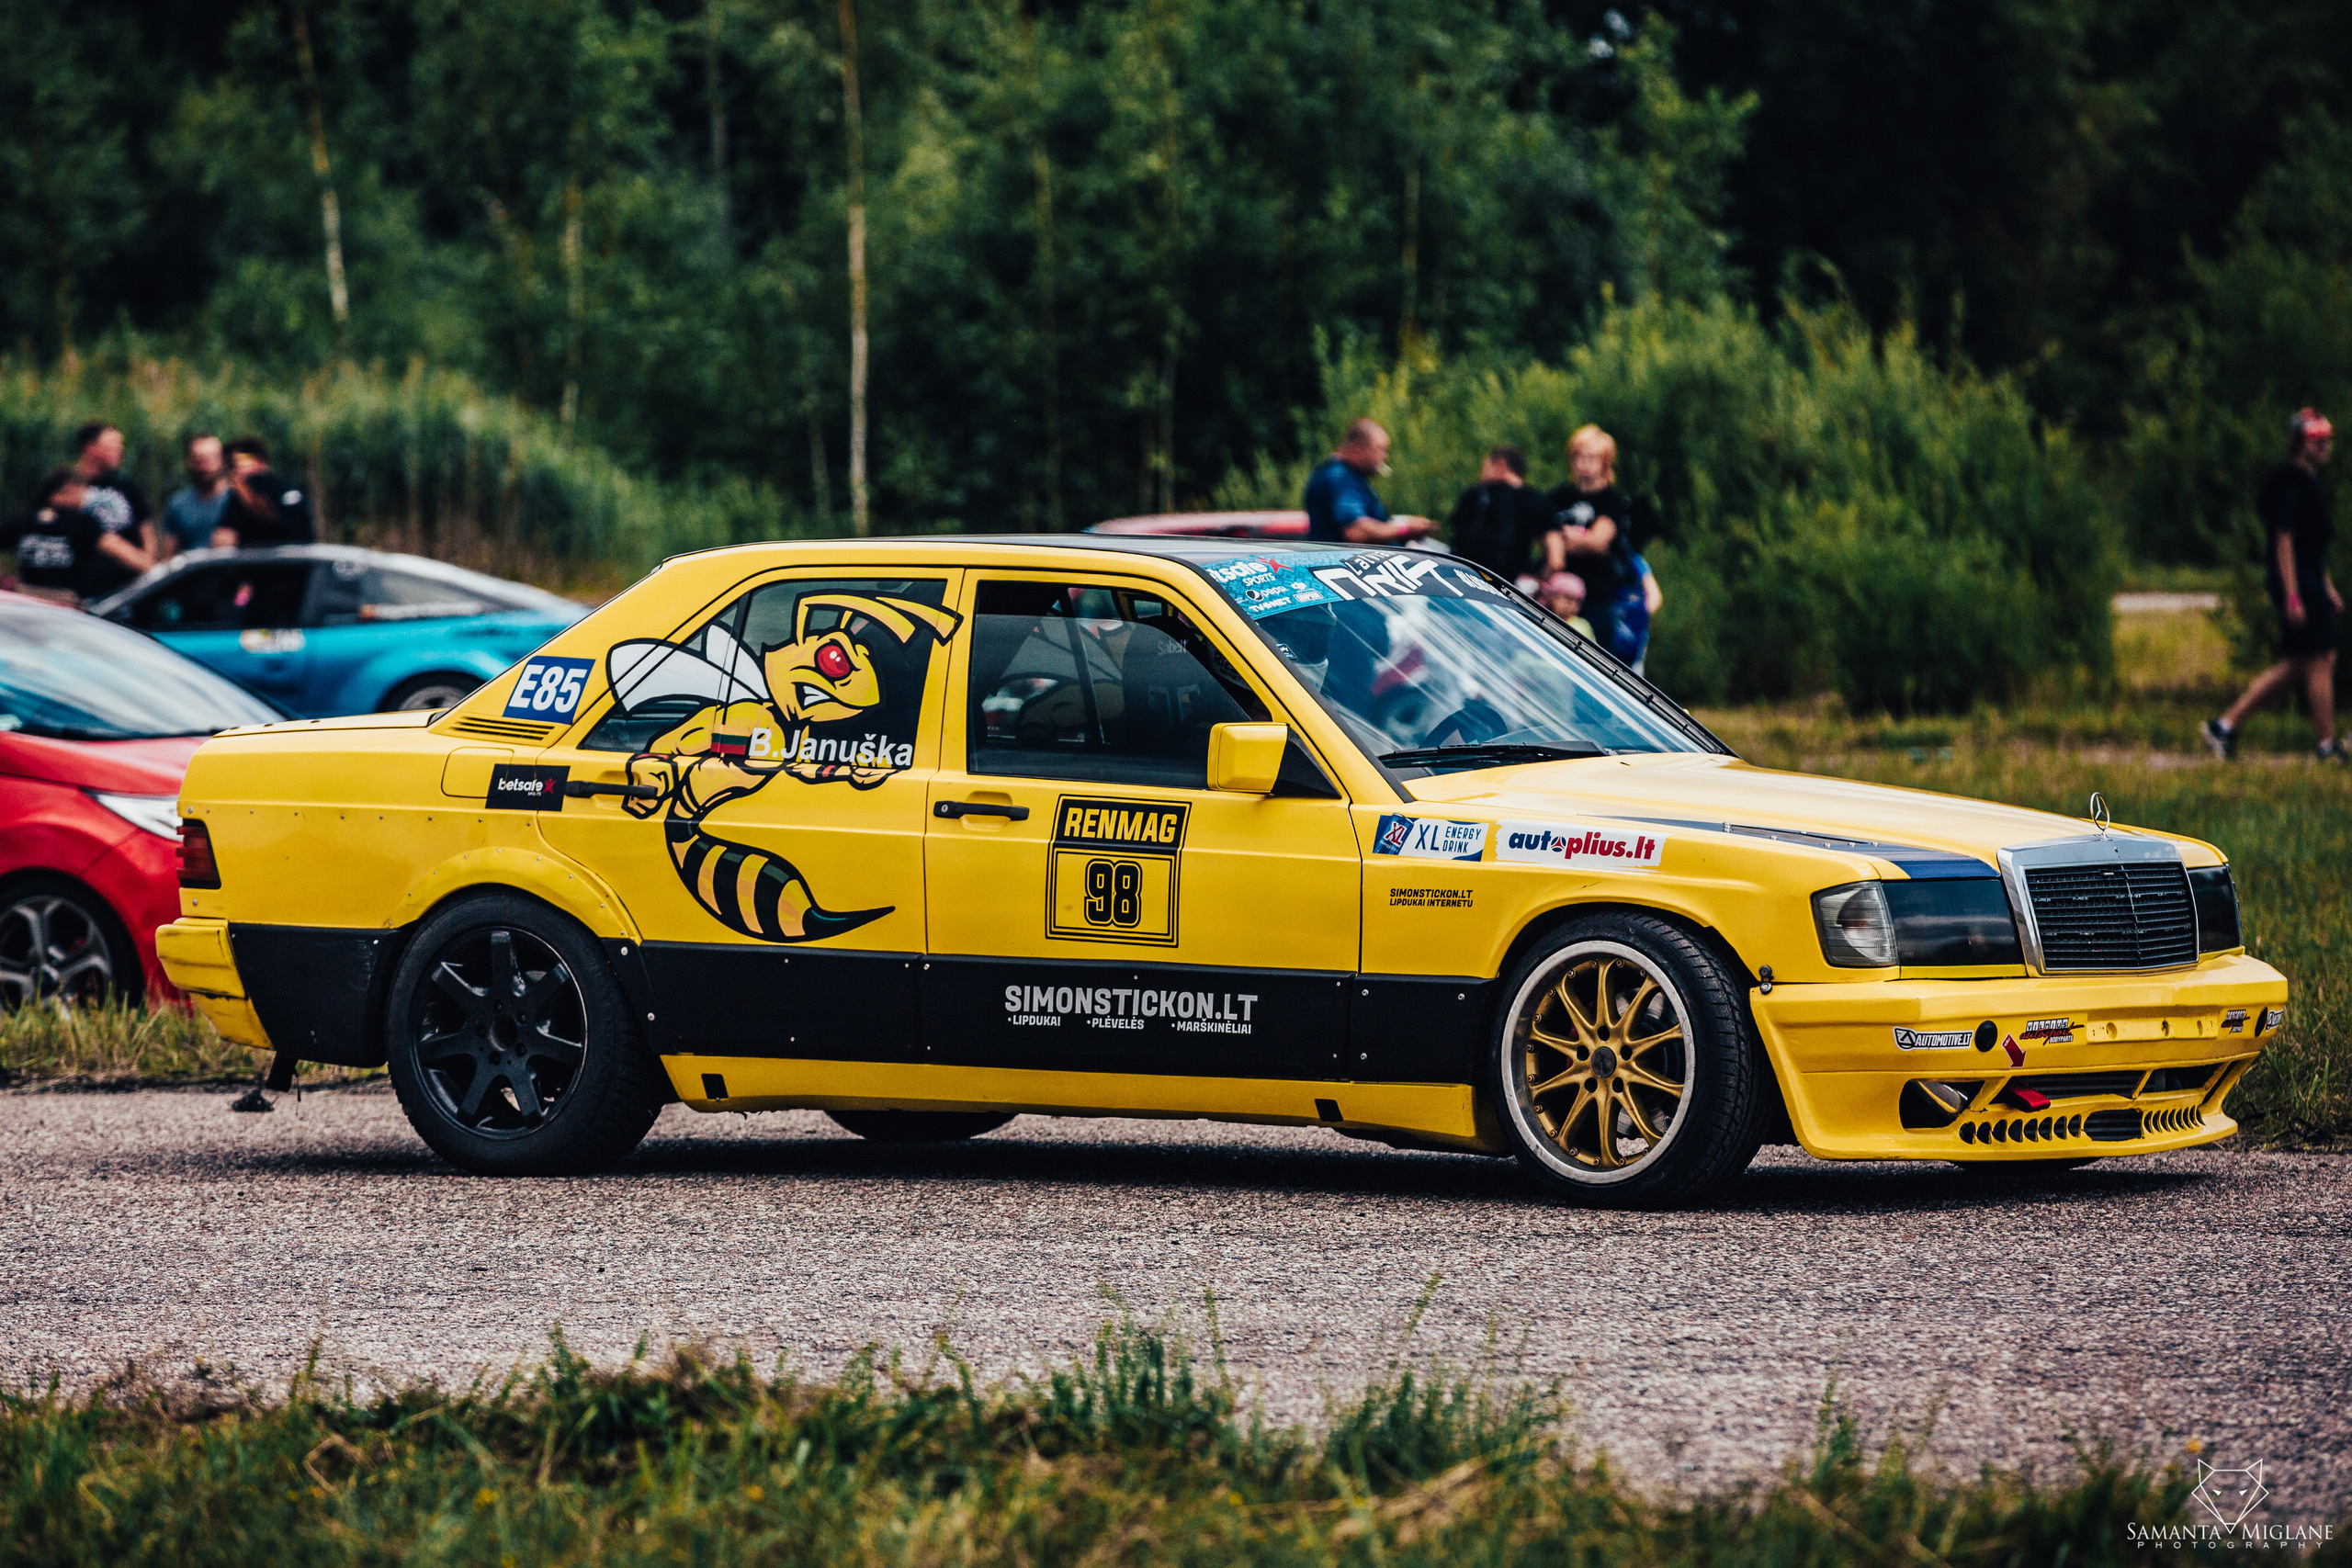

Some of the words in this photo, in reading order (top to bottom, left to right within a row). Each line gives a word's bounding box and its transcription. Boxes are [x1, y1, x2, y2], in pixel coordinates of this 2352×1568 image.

[1242, 572, 1275, 587] SPORTS
[1261, 586, 1289, 598] pepsi
[508, 664, 586, 715] E85
[749, 728, 914, 766] B.Januška
[497, 778, 543, 791] betsafe
[1063, 807, 1178, 843] RENMAG
[1415, 823, 1440, 852] XL
[1445, 826, 1481, 840] ENERGY
[1442, 840, 1468, 853] DRINK
[1084, 858, 1143, 929] 98
[1389, 887, 1474, 899] SIMONSTICKON.LT
[1389, 897, 1425, 907] LIPDUKAI
[1427, 898, 1474, 908] INTERNETU
[1004, 985, 1259, 1021] SIMONSTICKON.LT
[1915, 1033, 1972, 1046] AUTOMOTIVE.LT
[2049, 1035, 2074, 1043] BODYPARTS
